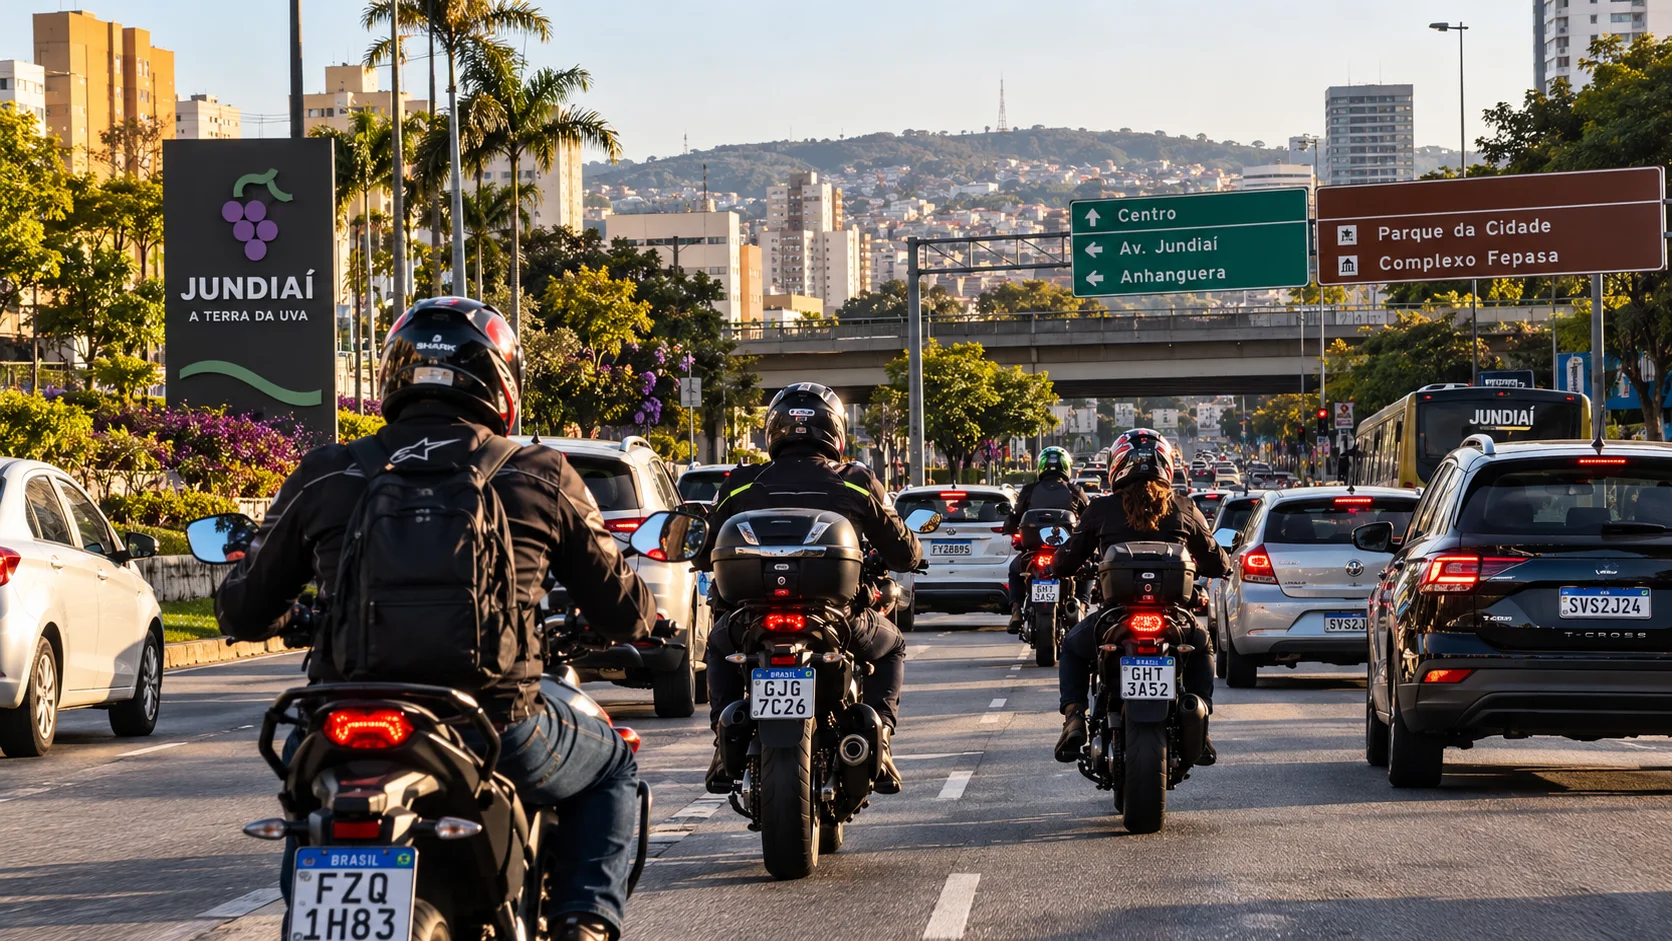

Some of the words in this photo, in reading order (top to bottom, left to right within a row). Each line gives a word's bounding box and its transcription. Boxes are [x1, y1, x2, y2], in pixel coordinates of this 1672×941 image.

[1118, 207, 1177, 223] Centro
[1378, 226, 1444, 243] Parque
[1453, 222, 1476, 238] da
[1486, 218, 1551, 236] Cidade
[1119, 241, 1146, 256] Av.
[1155, 236, 1218, 254] Jundiaí
[1379, 253, 1476, 273] Complexo
[1488, 250, 1559, 268] Fepasa
[180, 268, 316, 301] JUNDIAÍ
[1120, 267, 1226, 285] Anhanguera
[189, 310, 199, 322] A
[204, 310, 250, 322] TERRA
[255, 310, 275, 321] DA
[279, 310, 309, 321] UVA
[416, 342, 457, 352] SHARK
[1469, 405, 1535, 426] JUNDIAÍ
[1569, 597, 1641, 614] SVS2J24
[1131, 667, 1163, 681] GHT
[764, 680, 801, 697] GJG
[1127, 682, 1168, 696] 3A52
[759, 698, 806, 715] 7C26
[330, 854, 379, 866] BRASIL
[316, 872, 389, 904] FZQ
[303, 908, 396, 941] 1H83
